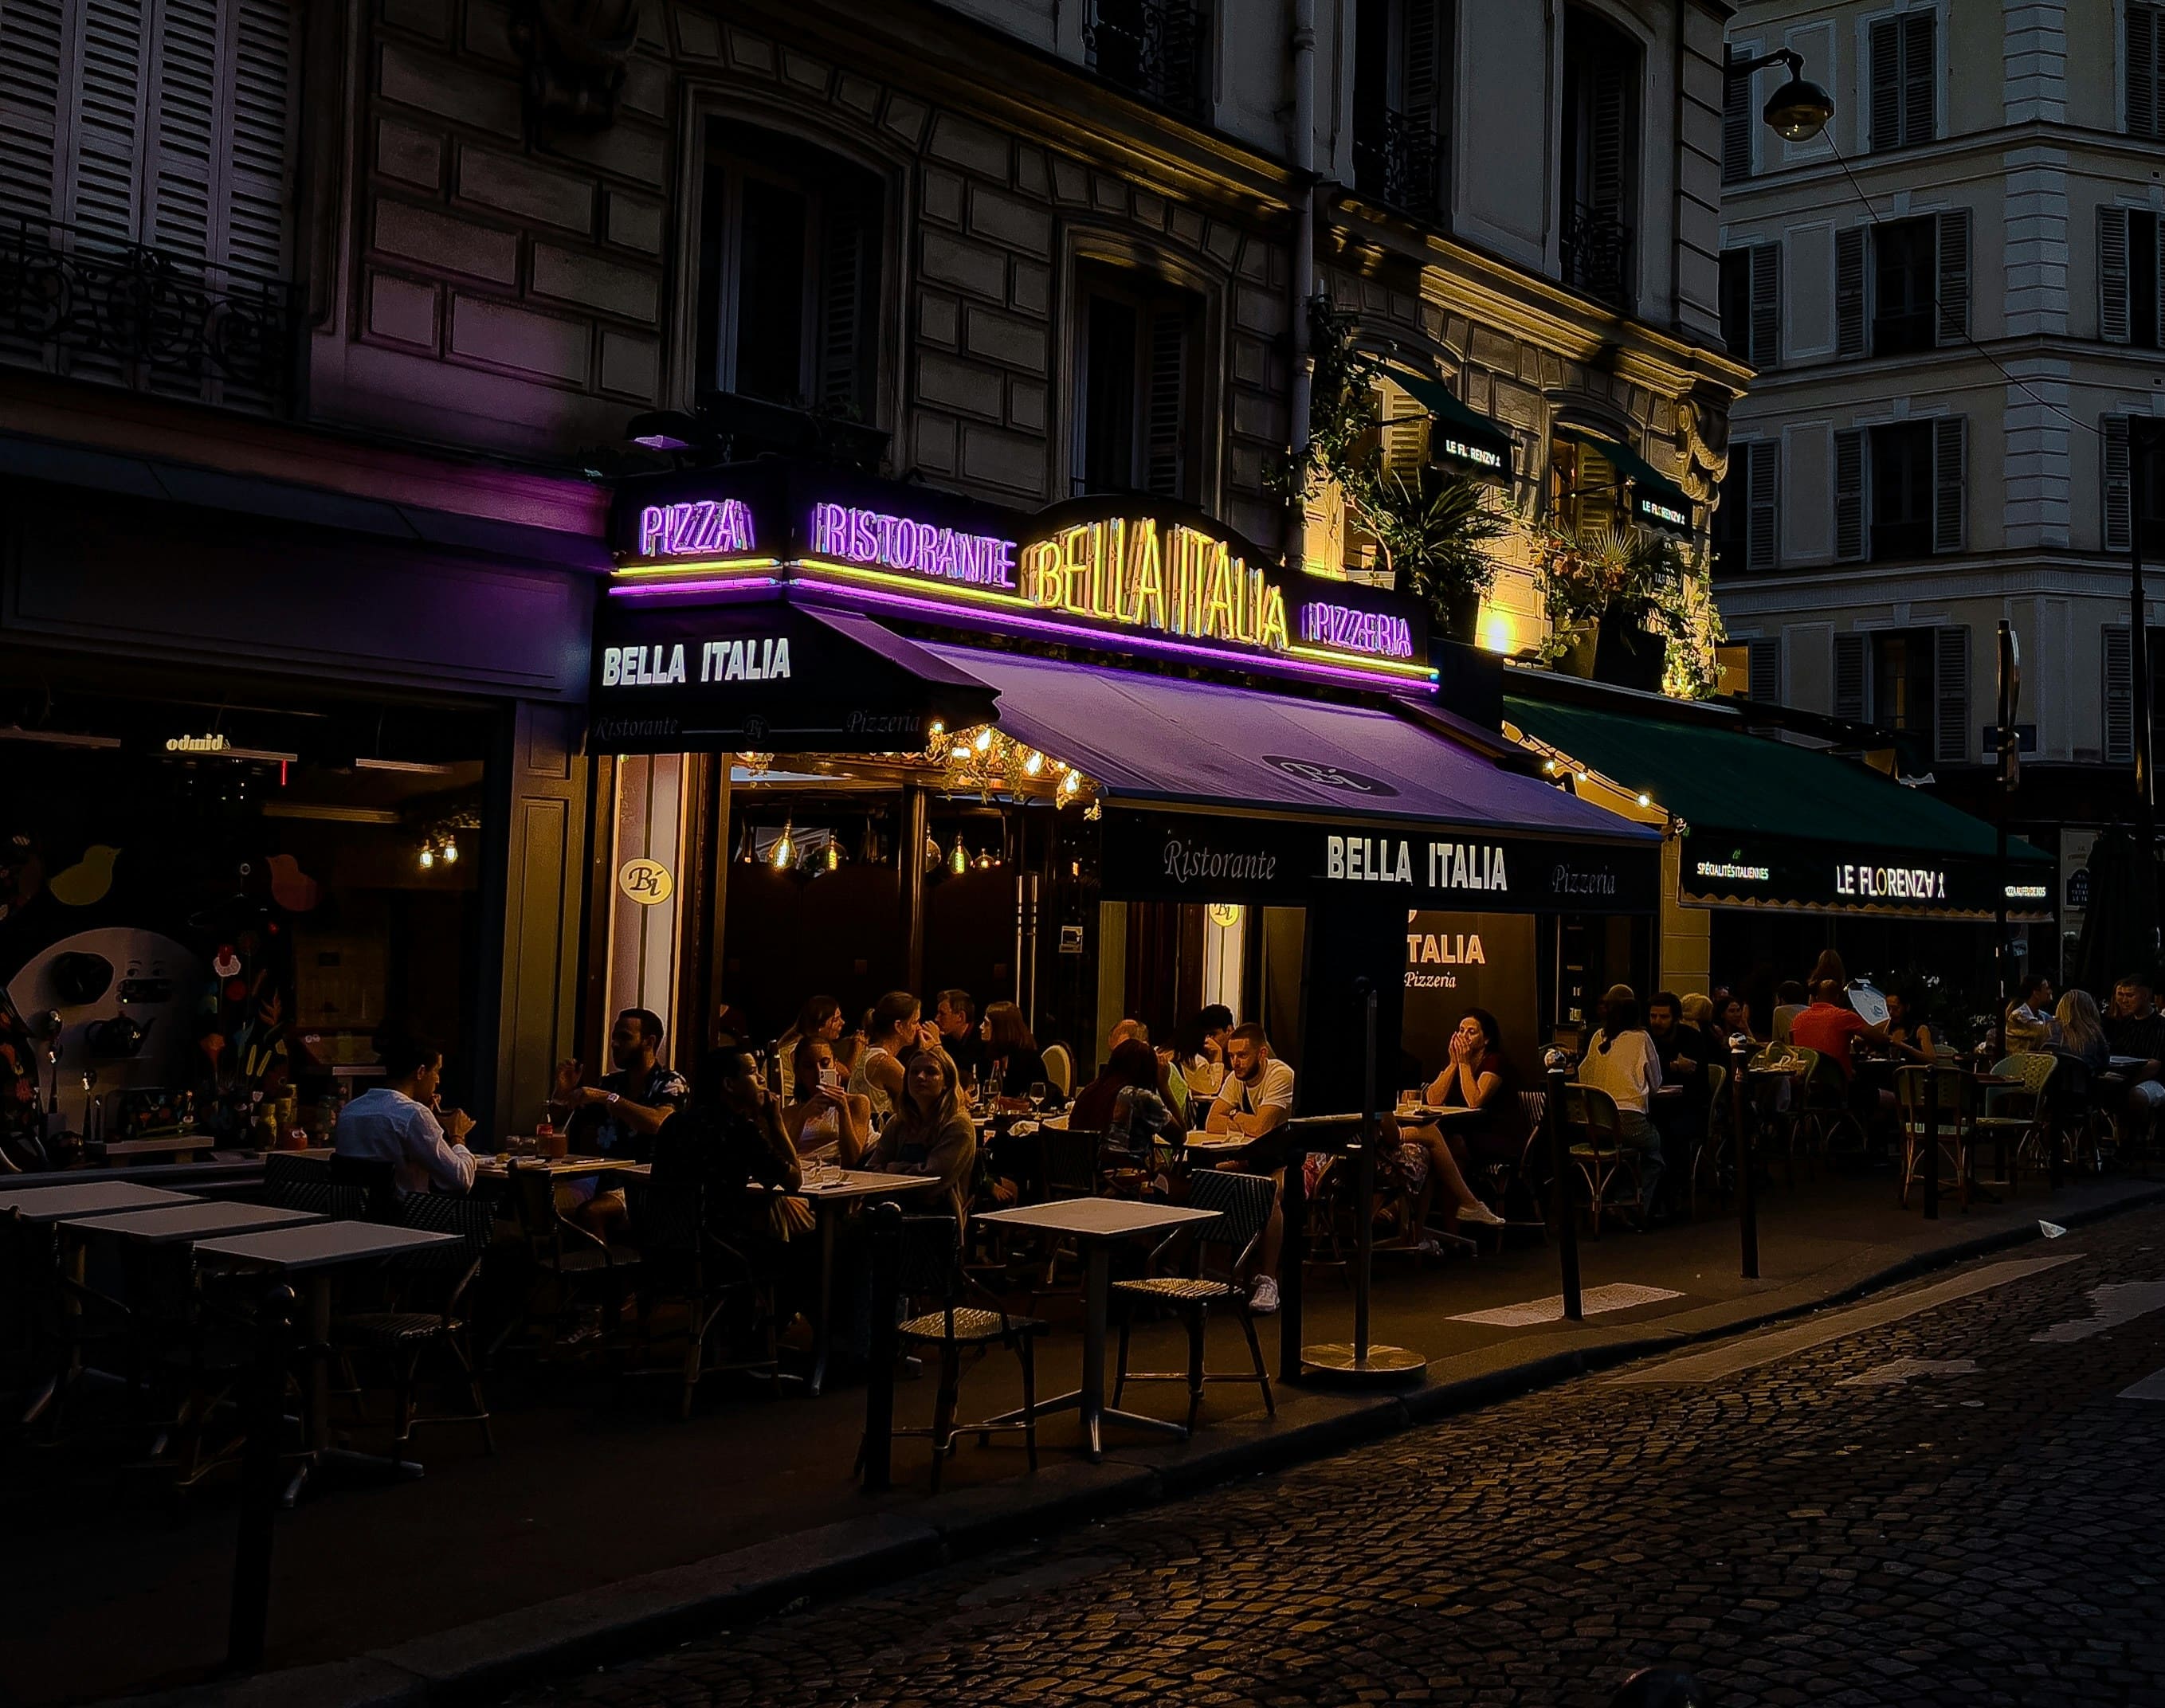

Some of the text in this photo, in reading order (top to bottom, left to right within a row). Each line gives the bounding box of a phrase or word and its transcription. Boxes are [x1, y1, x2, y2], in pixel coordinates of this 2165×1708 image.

[1445, 439, 1457, 454] LE
[641, 499, 754, 557] PIZZA
[814, 503, 1018, 589] RISTORANTE
[1032, 518, 1290, 651] BELLA ITALIA
[1305, 601, 1414, 657] PIZZERIA
[602, 637, 791, 687] BELLA ITALIA
[594, 716, 677, 741] Ristorante
[848, 708, 920, 735] Pizzeria
[1163, 835, 1617, 894] Ristorante BELLA ITALIA Pizzeria
[1836, 864, 1935, 899] LE FLORENZA
[1406, 934, 1486, 965] TALIA
[1404, 970, 1457, 989] Pizzeria
